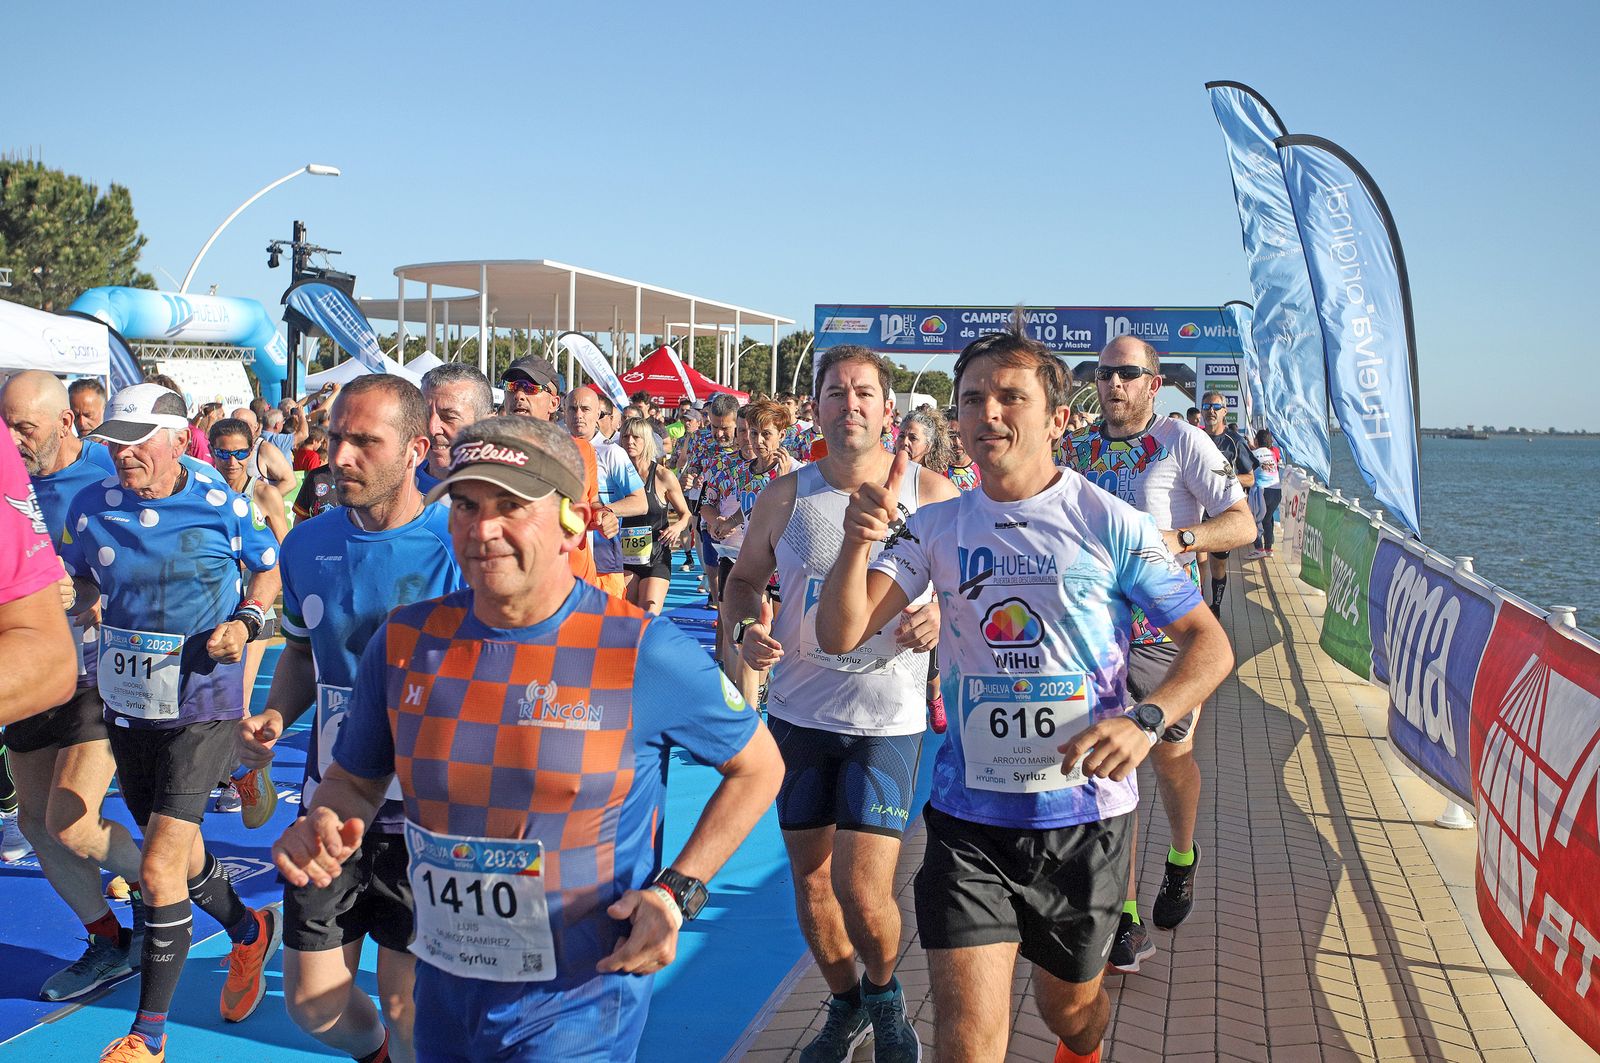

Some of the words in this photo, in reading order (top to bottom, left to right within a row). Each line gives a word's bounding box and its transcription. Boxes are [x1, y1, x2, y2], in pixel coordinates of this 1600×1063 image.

[960, 327, 976, 338] de
[1034, 325, 1057, 341] 10
[1062, 325, 1092, 341] km
[1129, 322, 1169, 336] HUELVA
[1203, 325, 1240, 338] WiHu
[922, 335, 944, 343] WiHu
[448, 440, 529, 470] Titleist
[621, 537, 646, 549] 1785
[993, 554, 1058, 576] HUELVA
[146, 639, 173, 651] 2023
[114, 652, 153, 680] 911
[836, 655, 862, 665] Syrluz
[991, 652, 1040, 669] WiHu
[983, 684, 1010, 694] HUELVA
[1039, 682, 1074, 697] 2023
[125, 700, 146, 710] Syrluz
[989, 707, 1056, 739] 616
[1013, 746, 1032, 754] LUIS
[992, 756, 1027, 765] ARROYO
[1028, 755, 1056, 764] MARÍN
[1013, 771, 1047, 783] Syrluz
[483, 848, 529, 869] 2023
[422, 869, 518, 919] 1410
[456, 922, 480, 932] LUIS
[459, 952, 499, 966] Syrluz
